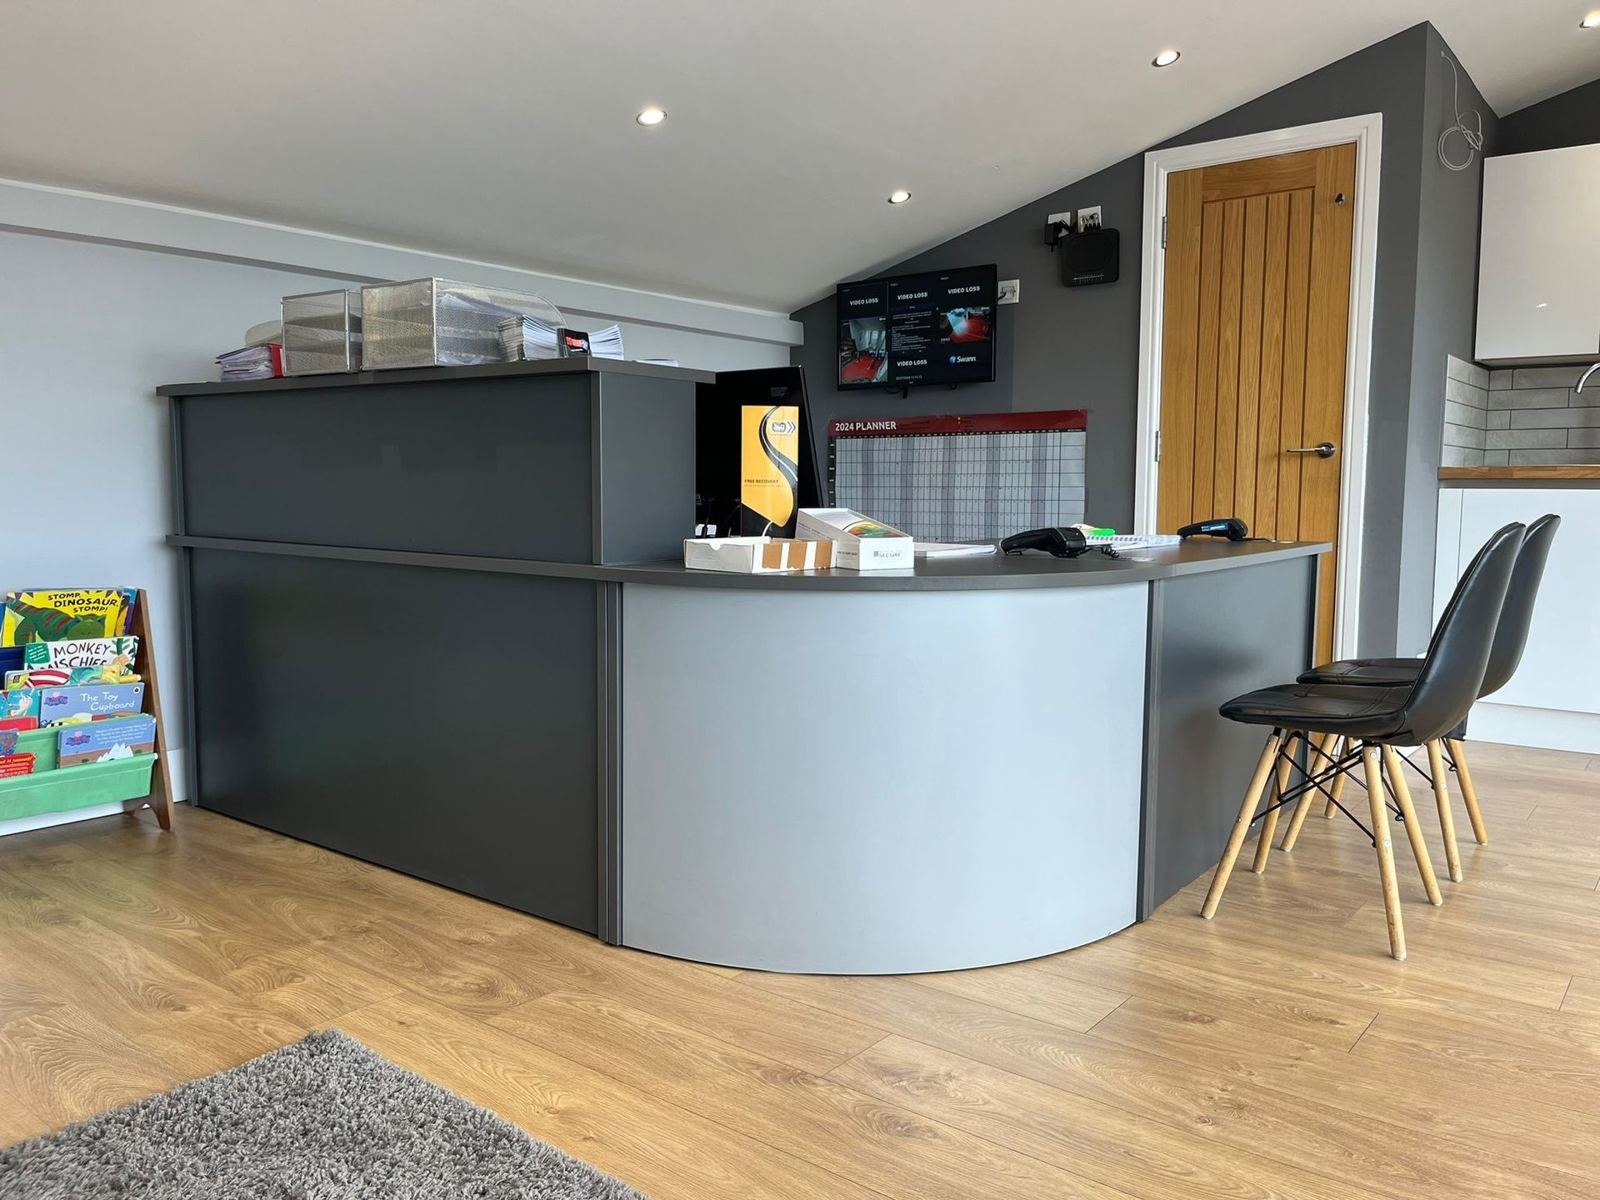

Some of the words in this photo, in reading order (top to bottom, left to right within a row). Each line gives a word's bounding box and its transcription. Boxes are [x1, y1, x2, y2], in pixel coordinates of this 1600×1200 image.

[914, 291, 928, 299] LOSS
[948, 287, 965, 295] VIDEO
[966, 285, 980, 293] LOSS
[866, 297, 879, 305] LOSS
[957, 355, 976, 363] Swann
[835, 422, 854, 432] 2024
[856, 421, 897, 431] PLANNER
[54, 598, 119, 608] DINOSAUR,
[53, 642, 111, 658] MONKEY
[80, 692, 99, 702] The
[102, 691, 119, 702] Toy
[90, 700, 135, 712] Cupboard
